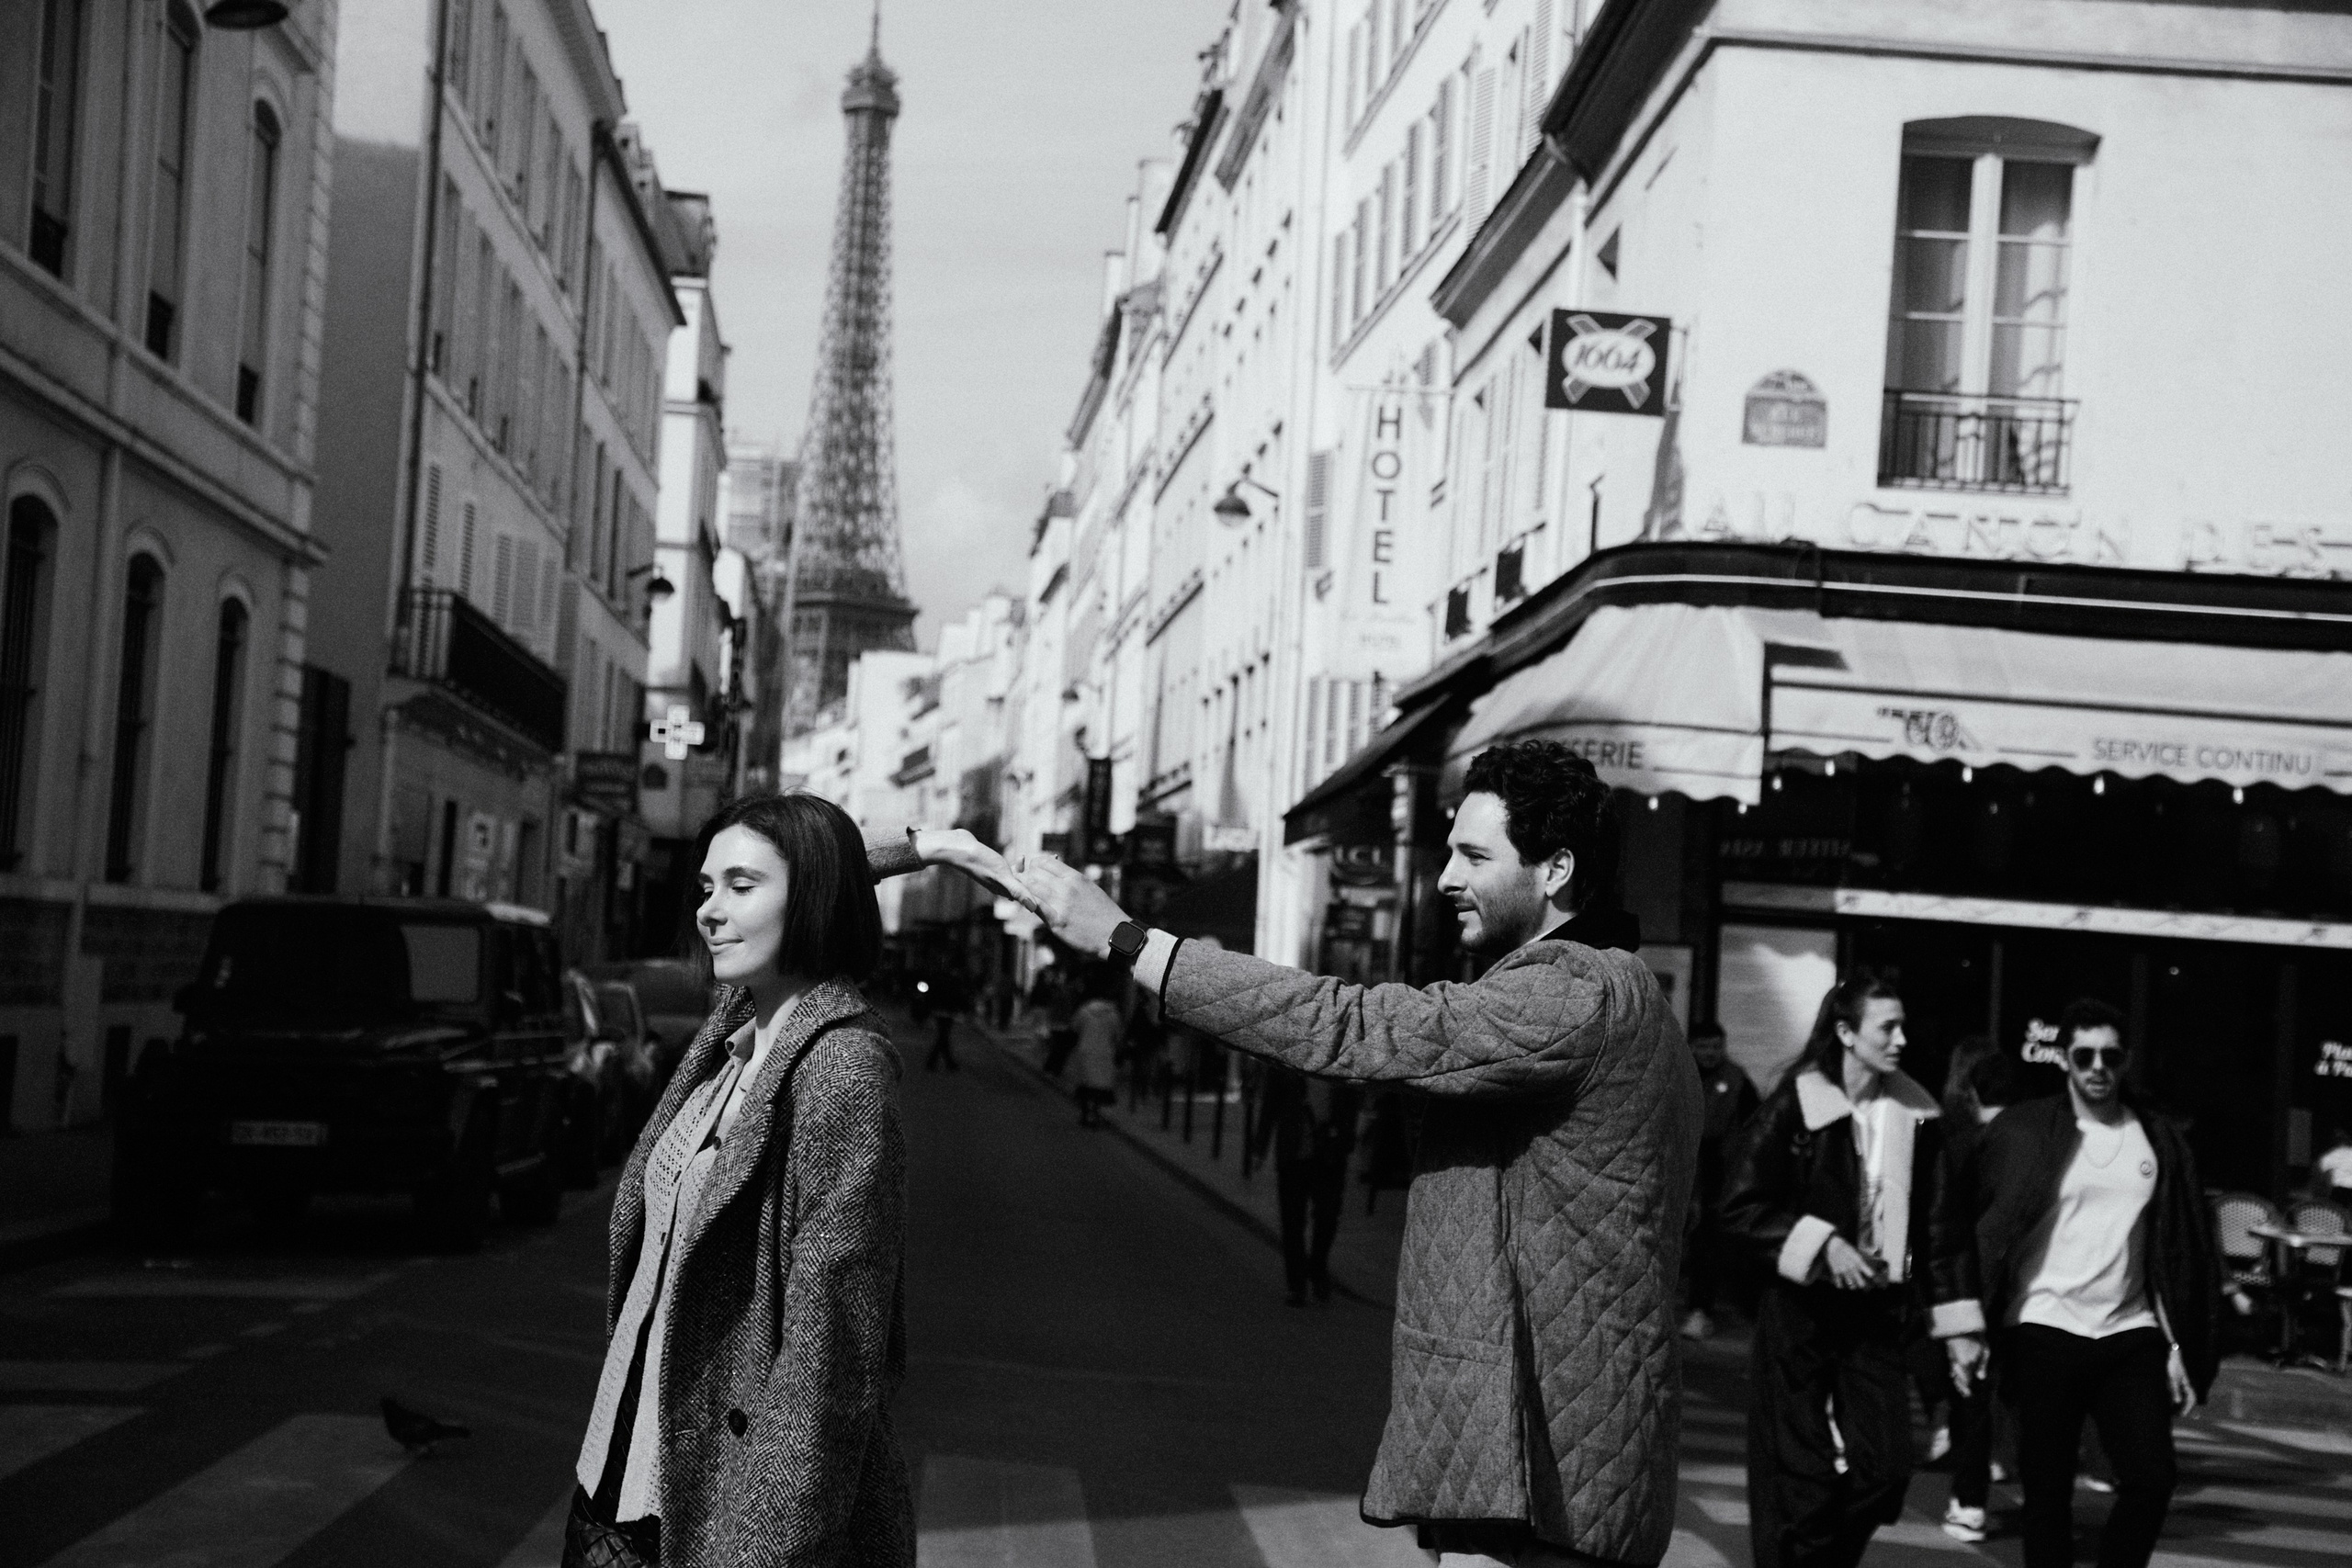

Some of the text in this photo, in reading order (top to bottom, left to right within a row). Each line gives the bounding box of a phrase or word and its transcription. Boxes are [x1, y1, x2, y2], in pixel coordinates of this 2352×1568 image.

[1371, 404, 1404, 606] HOTEL
[2094, 739, 2312, 777] SERVICE CONTINU
